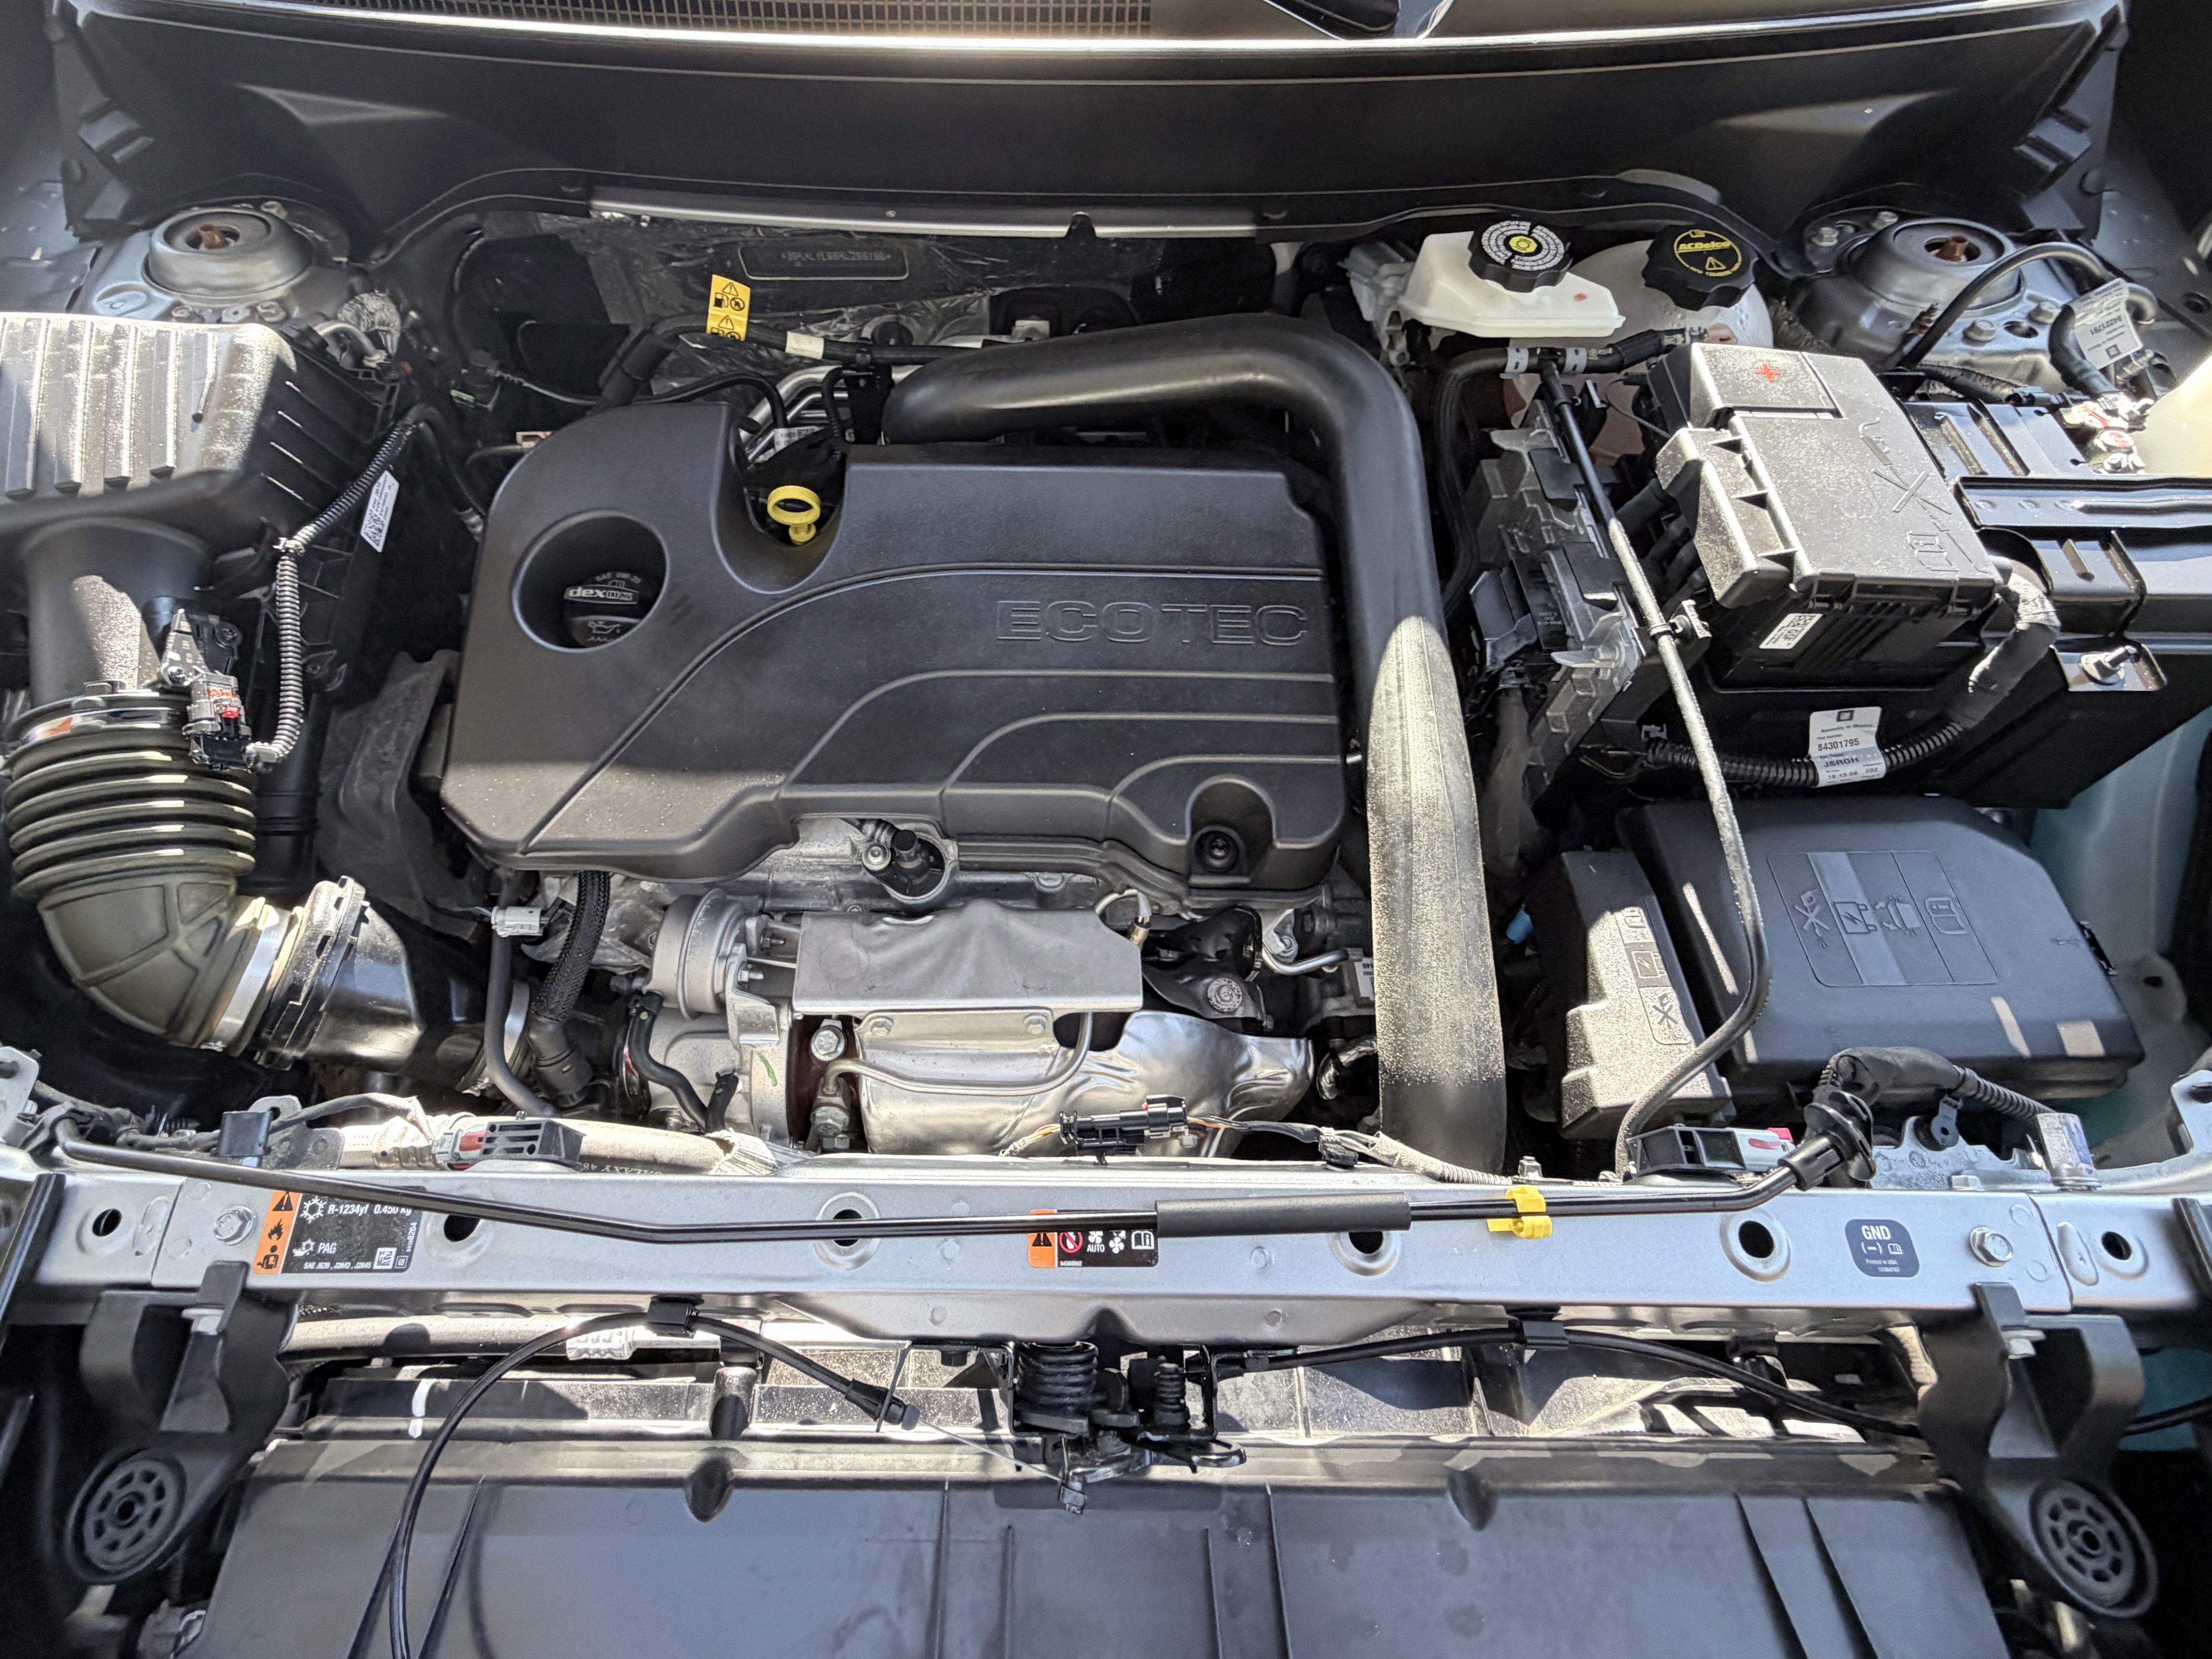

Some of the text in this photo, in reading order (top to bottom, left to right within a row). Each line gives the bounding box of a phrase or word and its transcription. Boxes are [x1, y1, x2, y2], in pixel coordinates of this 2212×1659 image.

[1678, 241, 1732, 251] ACDelco
[569, 587, 633, 601] dexos
[997, 600, 1308, 646] ECOTEC
[1817, 737, 1860, 751] 84301795
[328, 1203, 369, 1216] R-1234yf
[1862, 1225, 1891, 1240] GND
[318, 1242, 337, 1254] PAG
[1087, 1244, 1105, 1253] AUTO
